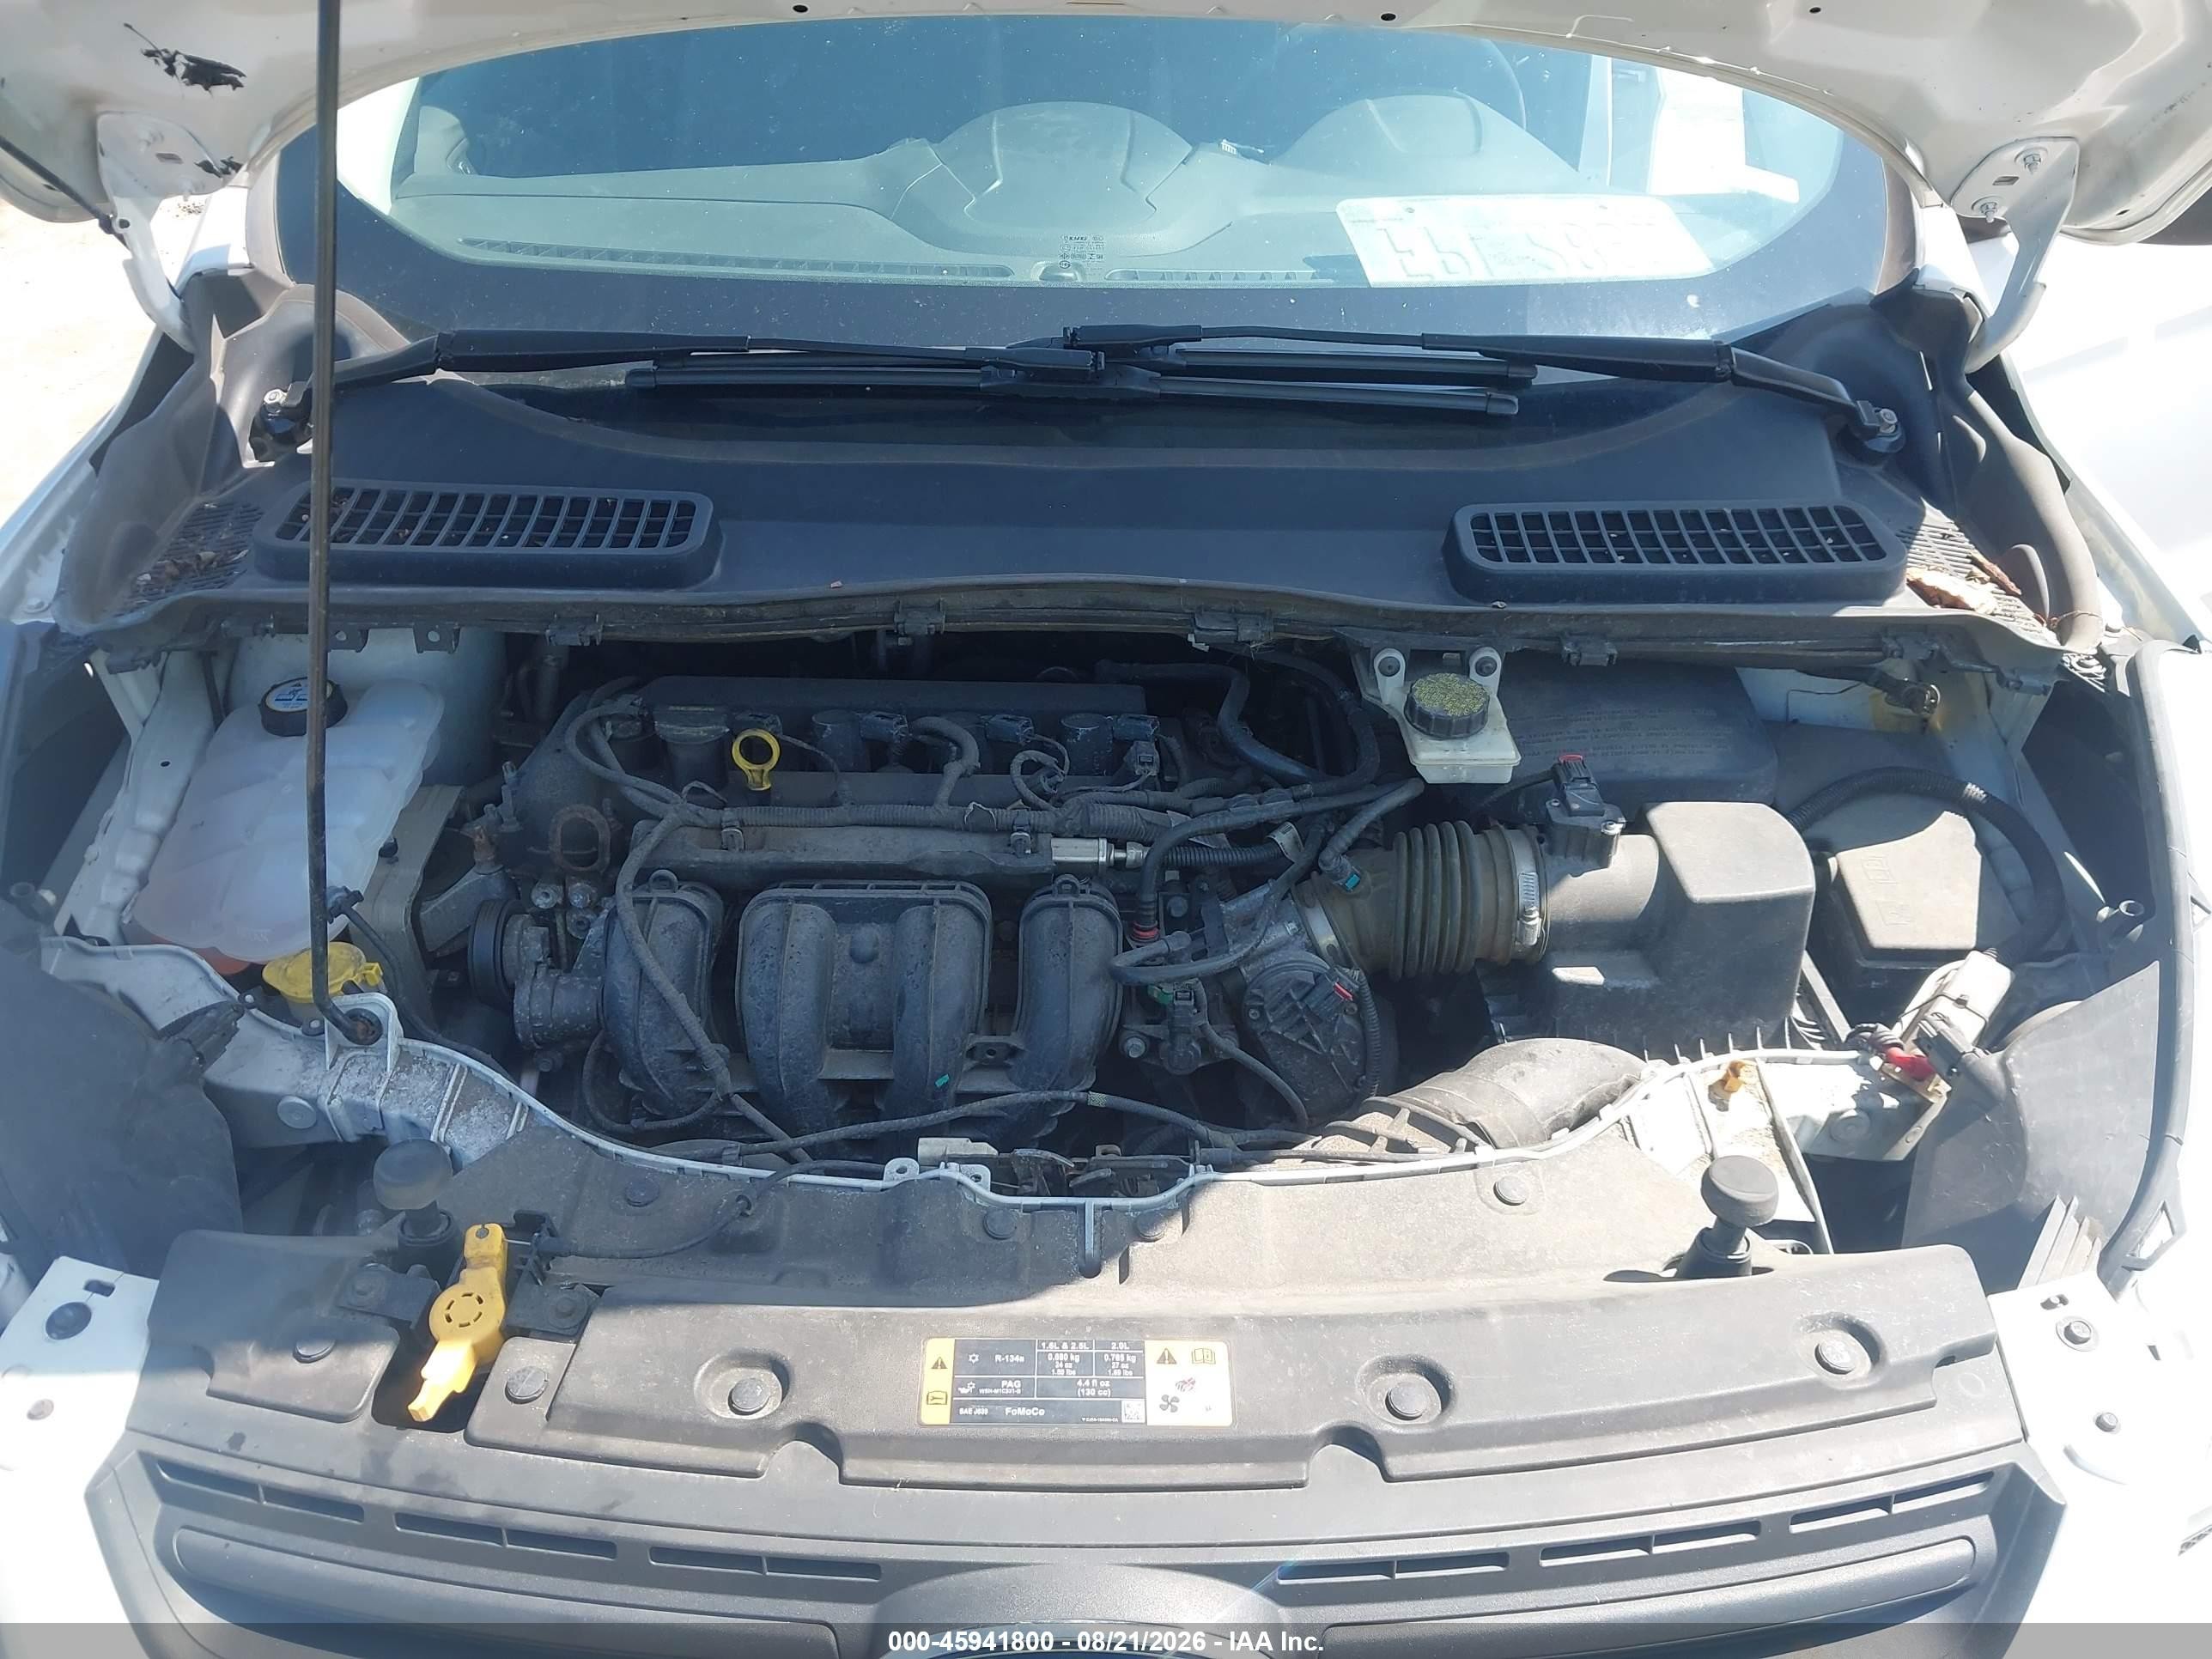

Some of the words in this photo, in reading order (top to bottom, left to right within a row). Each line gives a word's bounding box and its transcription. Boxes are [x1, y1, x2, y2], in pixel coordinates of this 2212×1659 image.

[994, 1353, 1025, 1364] R-134a
[1070, 1353, 1080, 1363] kg
[1127, 1354, 1137, 1364] kg
[1001, 1380, 1021, 1389] PAG
[1078, 1389, 1096, 1397] (130
[1097, 1389, 1111, 1397] cc)
[1005, 1407, 1045, 1417] FoMoCo
